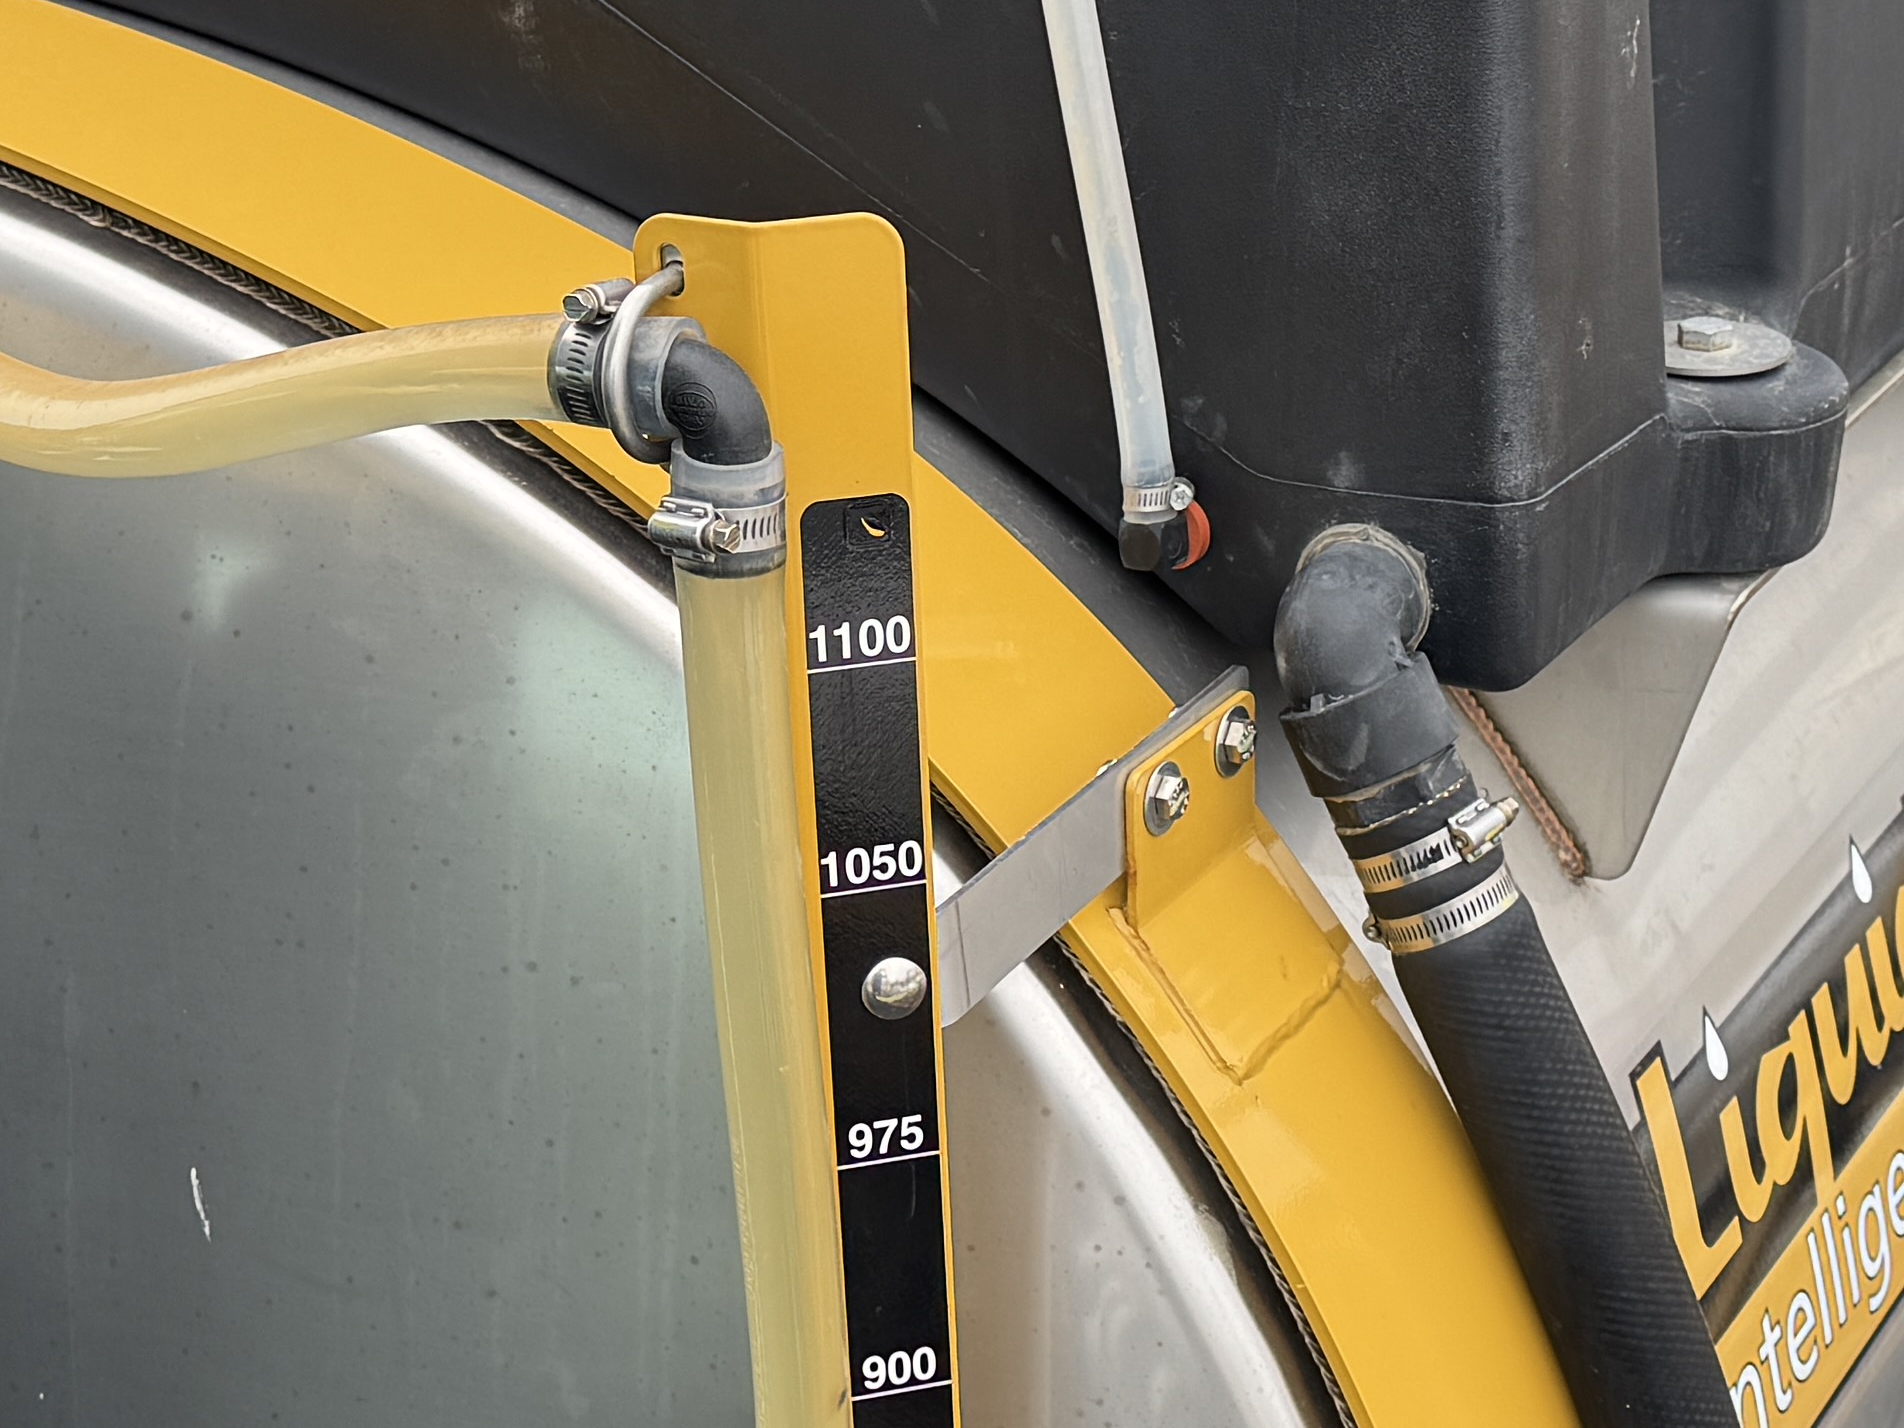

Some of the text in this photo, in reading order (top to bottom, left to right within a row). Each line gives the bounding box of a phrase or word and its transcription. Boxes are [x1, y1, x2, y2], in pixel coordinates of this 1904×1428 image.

[809, 615, 912, 664] 1100
[819, 840, 924, 888] 1050
[847, 1116, 924, 1160] 975
[861, 1346, 938, 1390] 900
